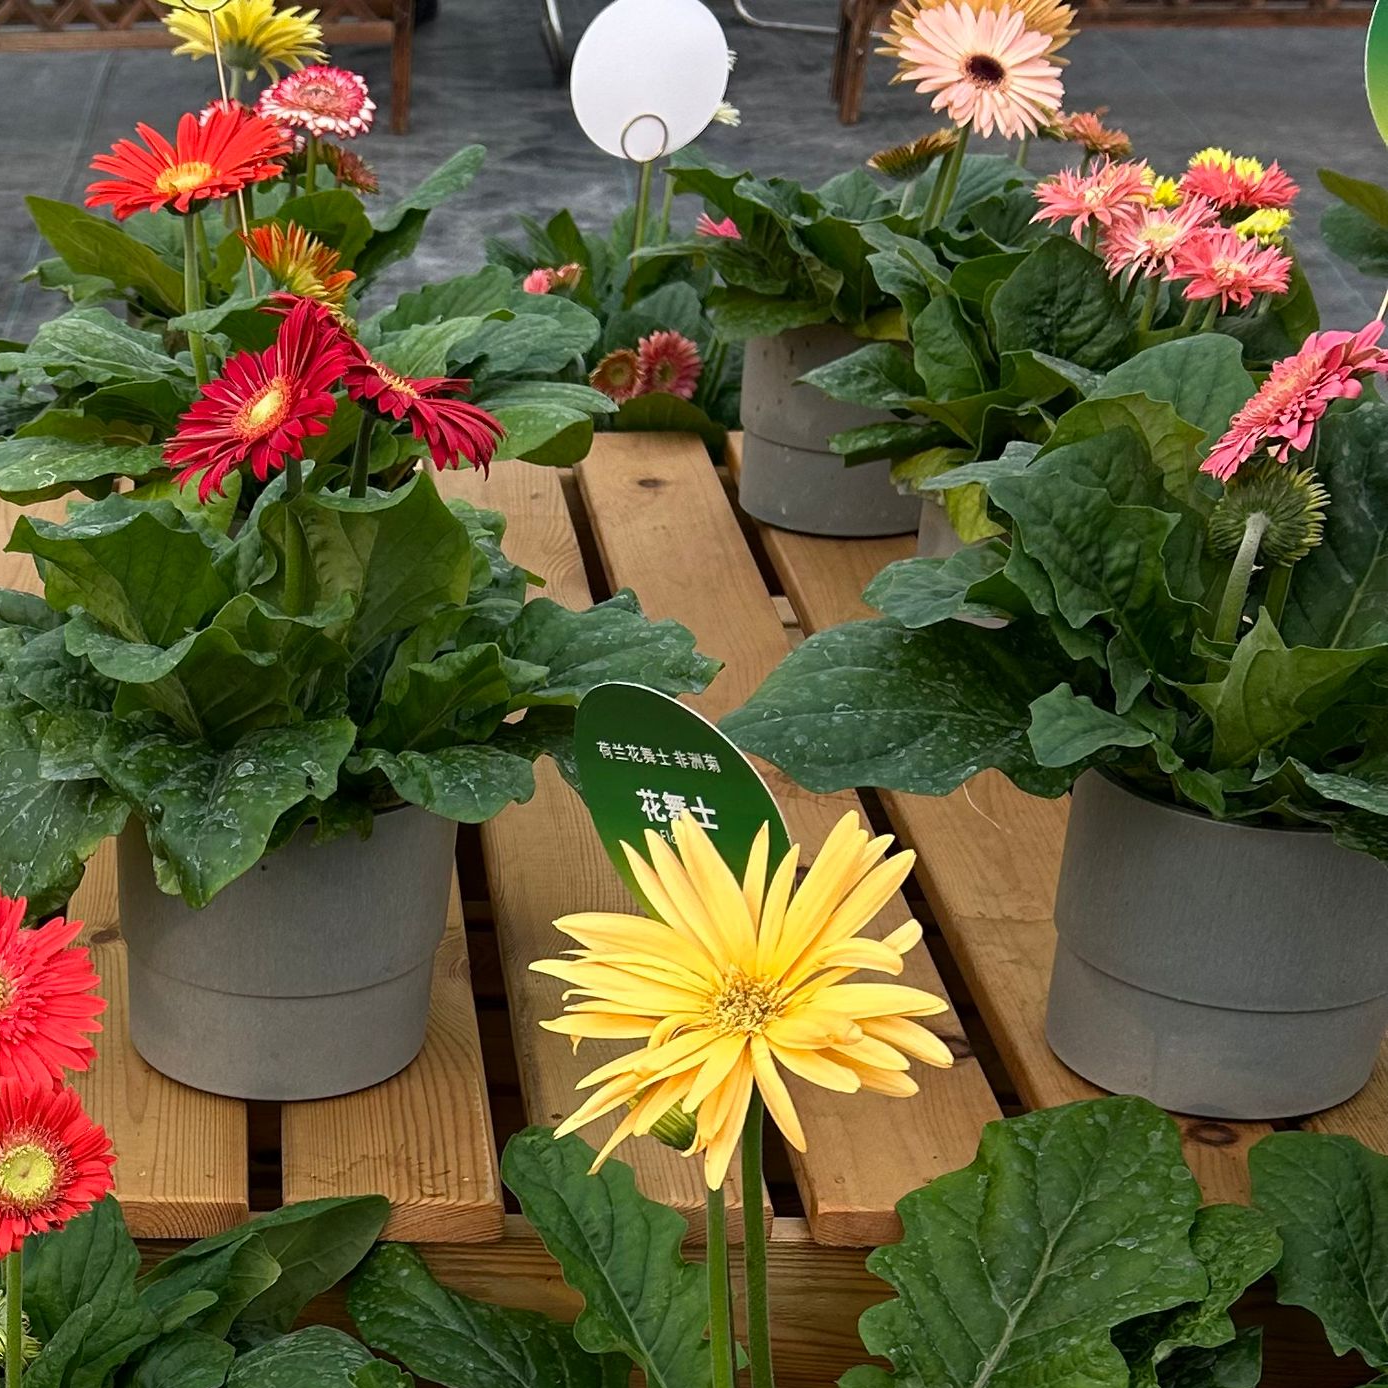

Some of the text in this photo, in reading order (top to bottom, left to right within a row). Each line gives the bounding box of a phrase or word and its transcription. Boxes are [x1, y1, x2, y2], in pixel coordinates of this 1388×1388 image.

[596, 741, 722, 773] 荷兰花舞士 非洲菊
